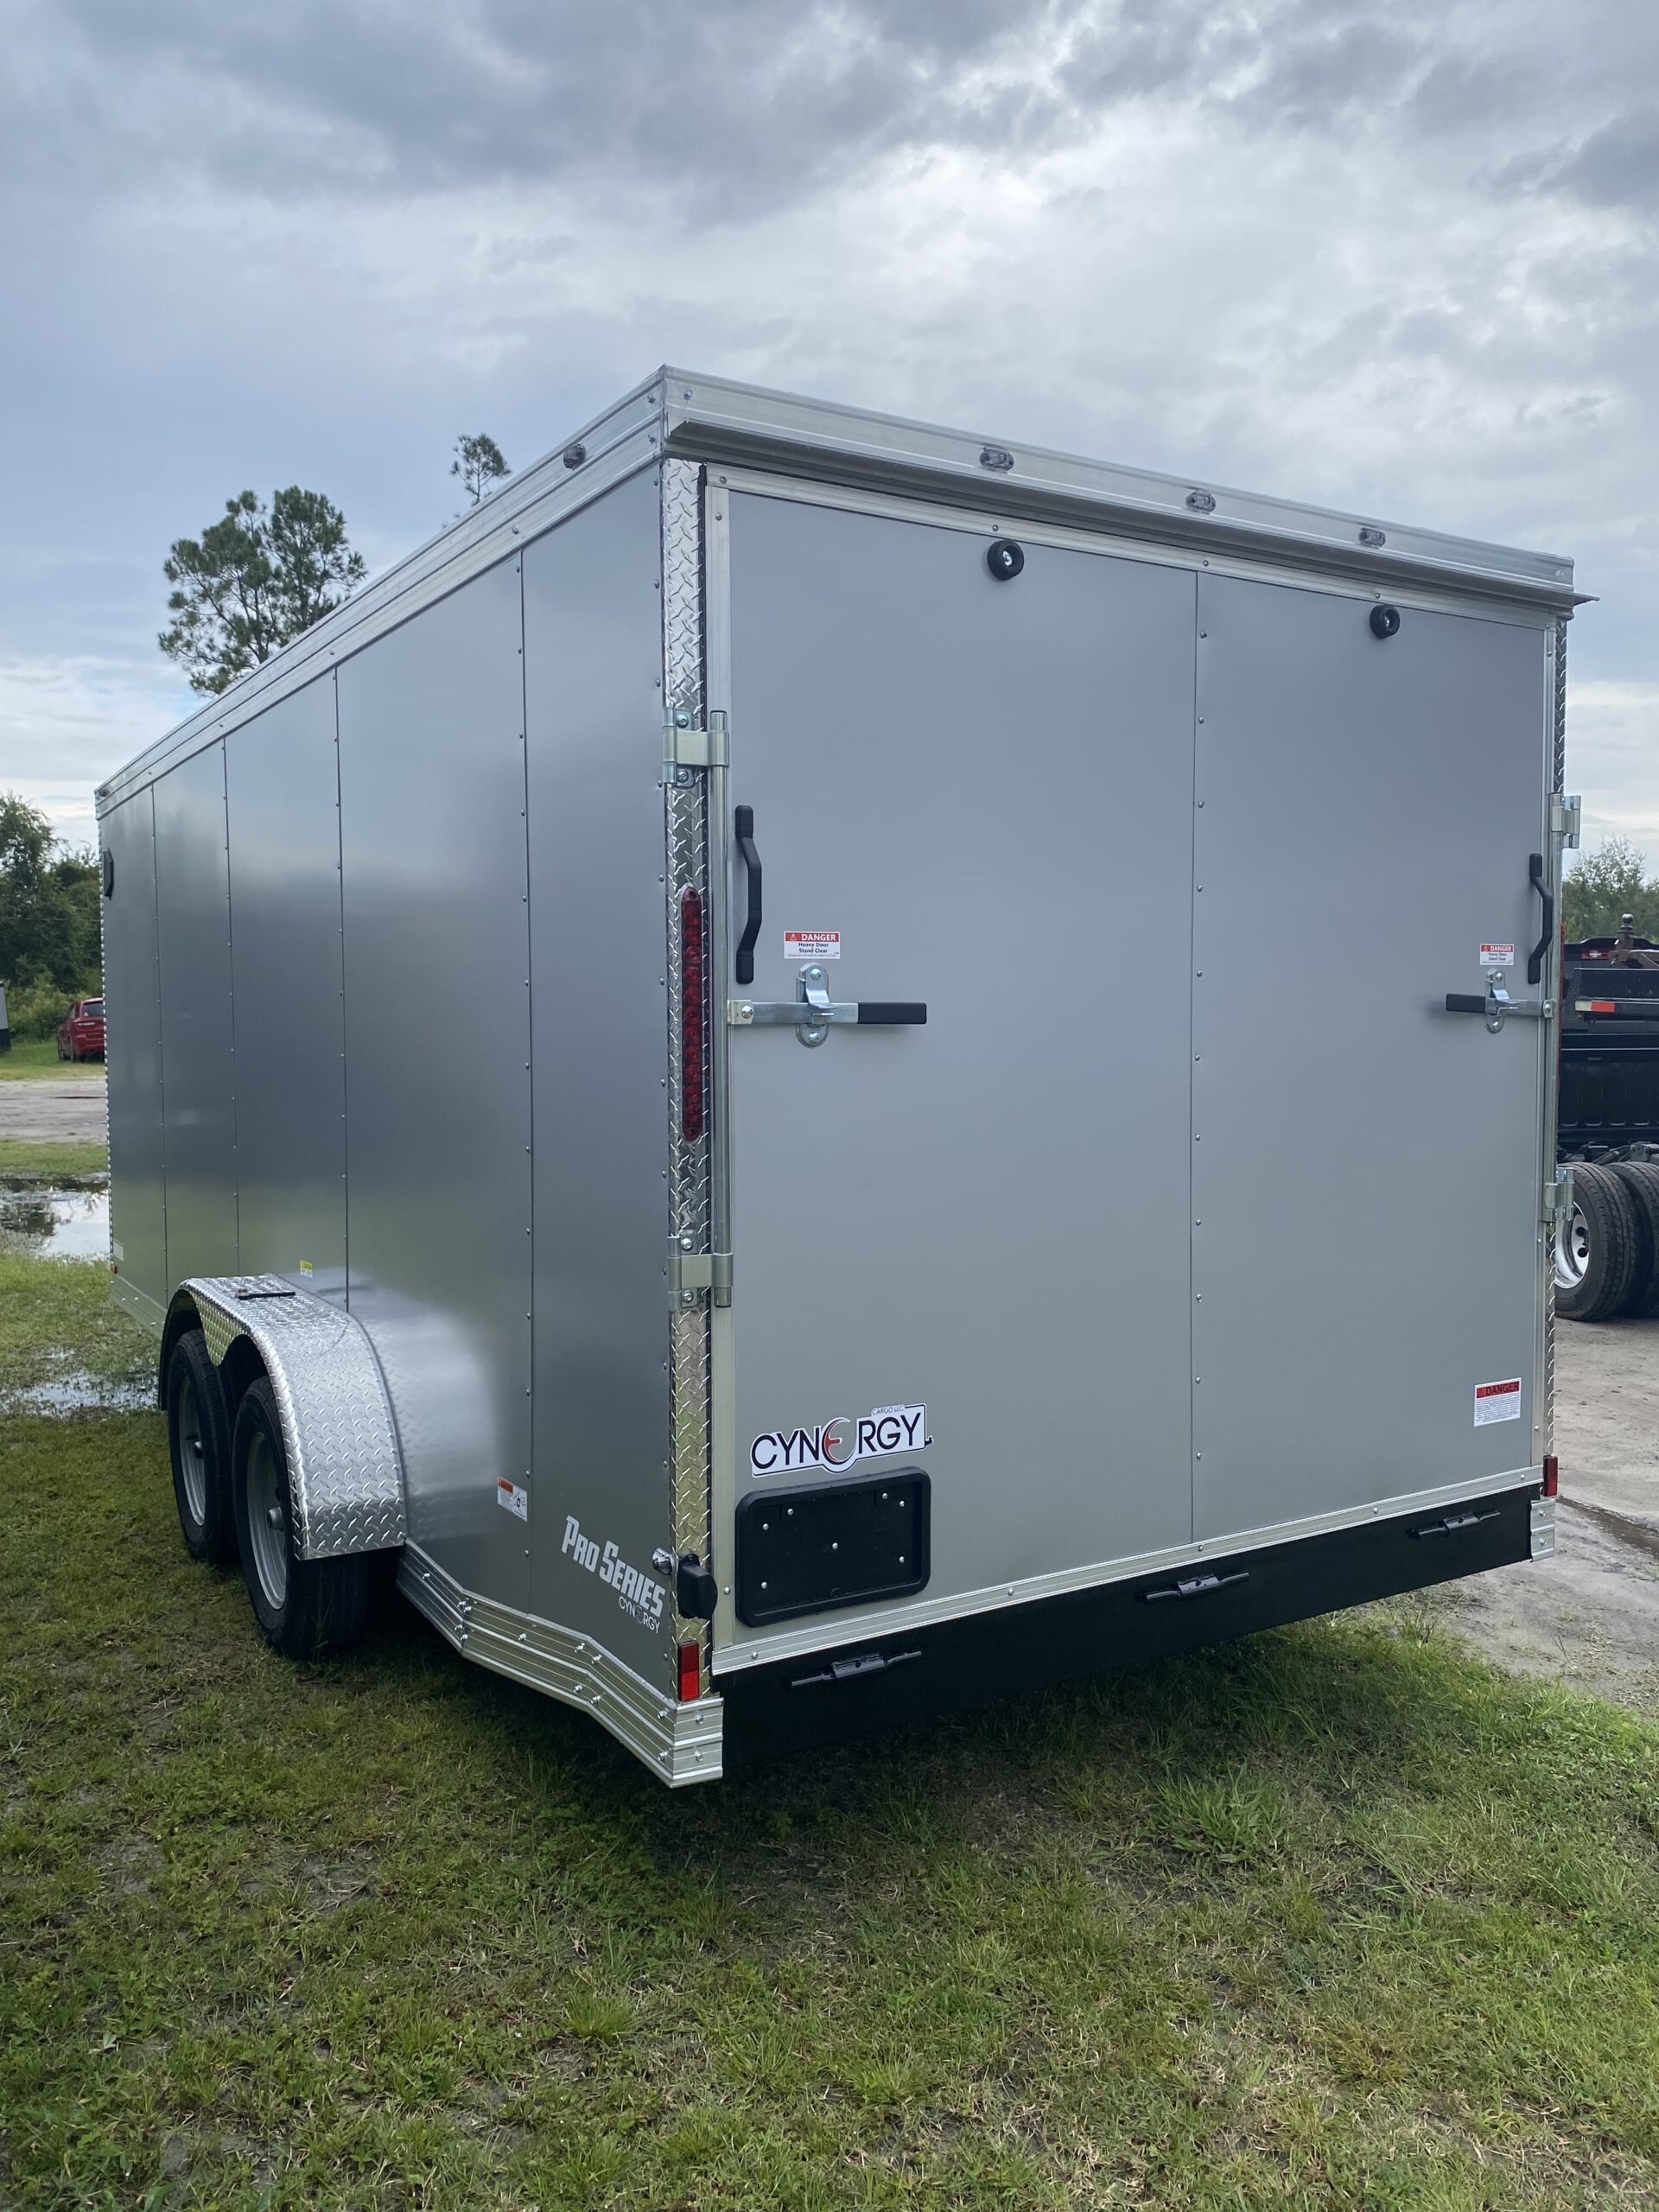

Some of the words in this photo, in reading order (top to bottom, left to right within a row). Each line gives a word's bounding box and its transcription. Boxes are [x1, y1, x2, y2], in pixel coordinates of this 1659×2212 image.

[1486, 1382, 1519, 1396] DANGER
[872, 1407, 893, 1415] CARGO
[752, 1413, 921, 1469] CYNERGY
[619, 1596, 660, 1634] CYNERGY
